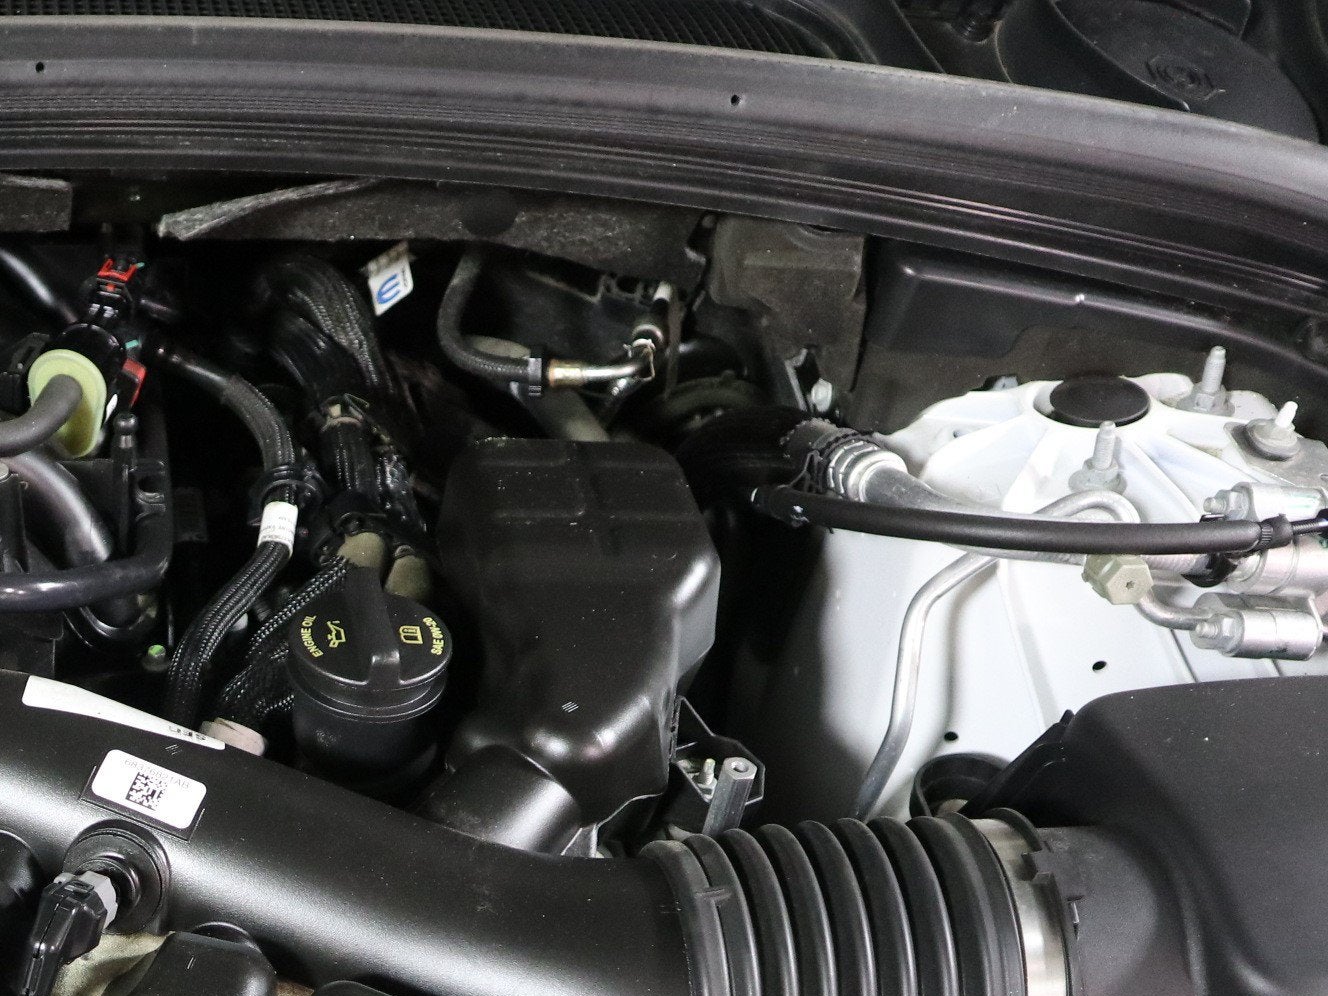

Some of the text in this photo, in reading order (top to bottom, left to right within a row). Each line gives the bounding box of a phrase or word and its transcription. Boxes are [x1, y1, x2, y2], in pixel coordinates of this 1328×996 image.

[300, 615, 325, 658] ENGINE OIL
[430, 639, 445, 656] SAE
